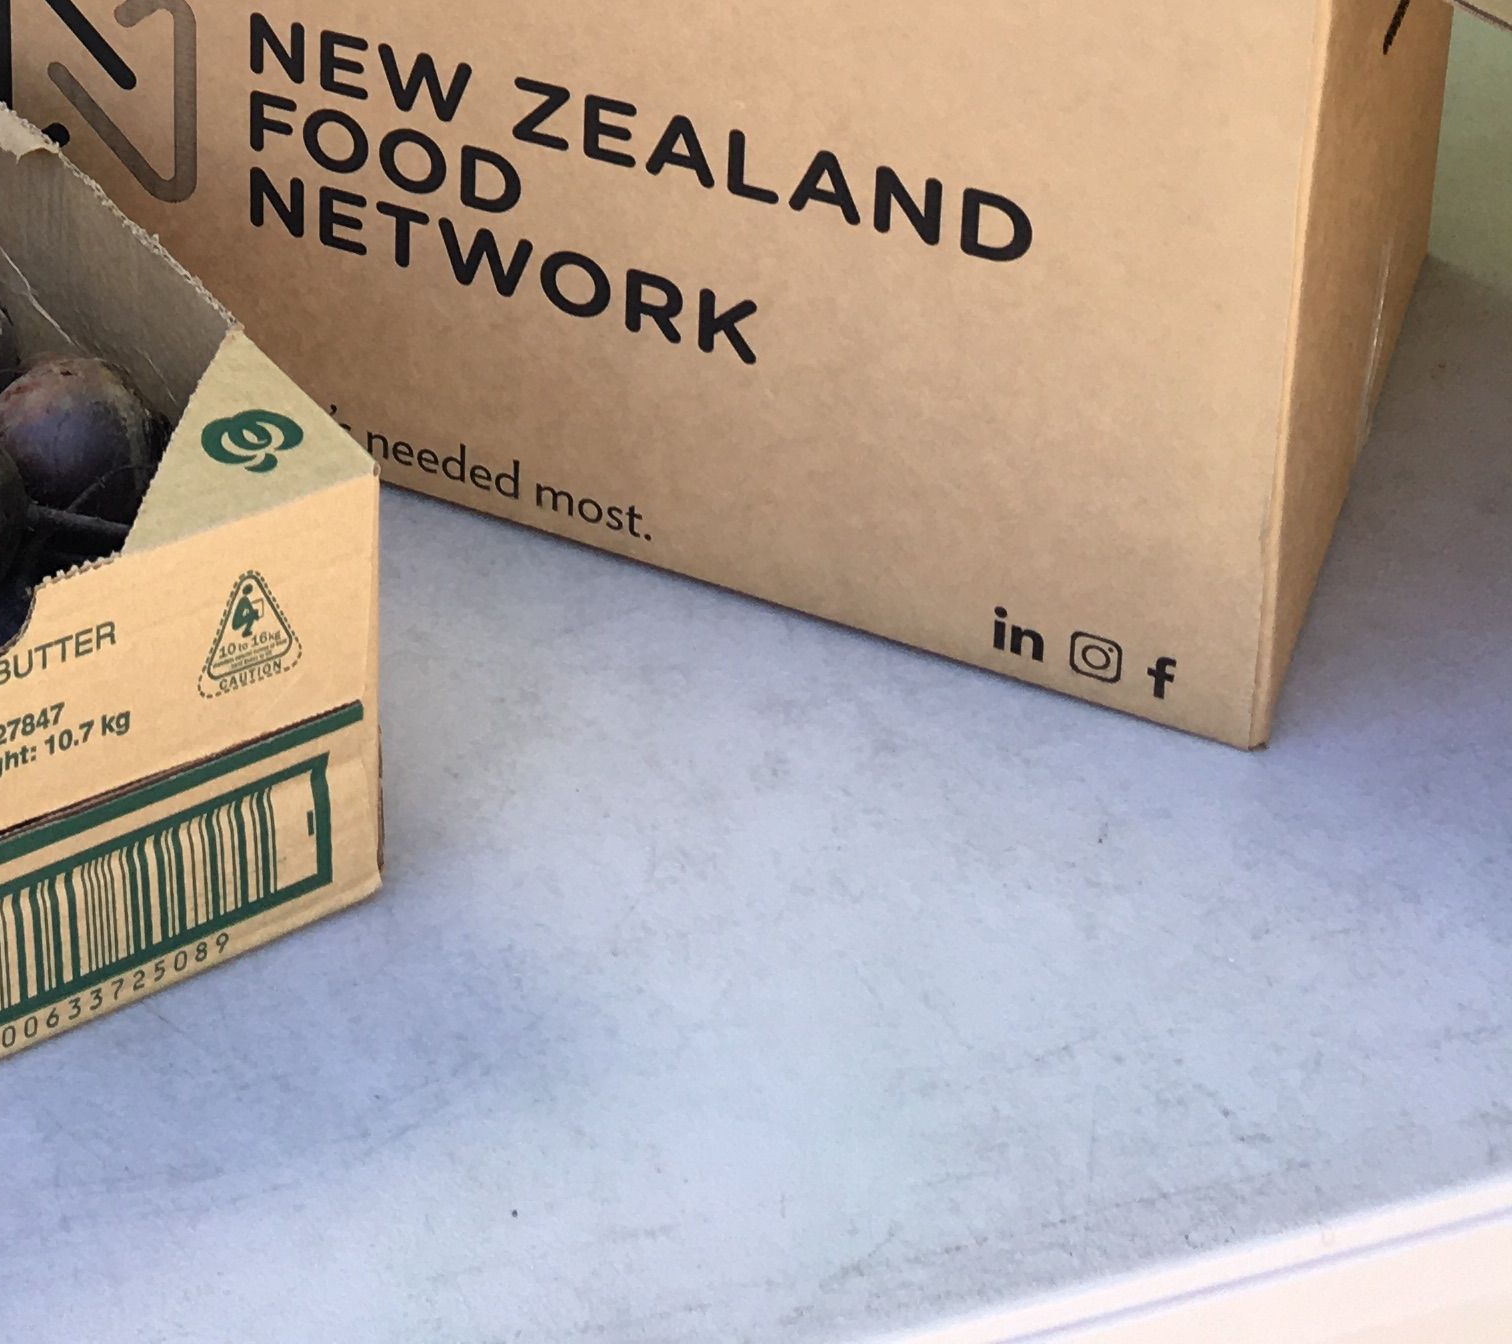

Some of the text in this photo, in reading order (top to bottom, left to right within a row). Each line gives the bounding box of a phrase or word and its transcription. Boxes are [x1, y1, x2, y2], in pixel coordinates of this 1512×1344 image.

[249, 11, 1035, 263] NEW ZEALAND
[249, 90, 522, 214] FOOD
[249, 166, 759, 365] NETWORK
[366, 430, 653, 542] needed most.
[218, 642, 237, 660] 10
[219, 658, 282, 691] CAUTION
[43, 720, 94, 757] 10.7
[101, 709, 132, 736] kg
